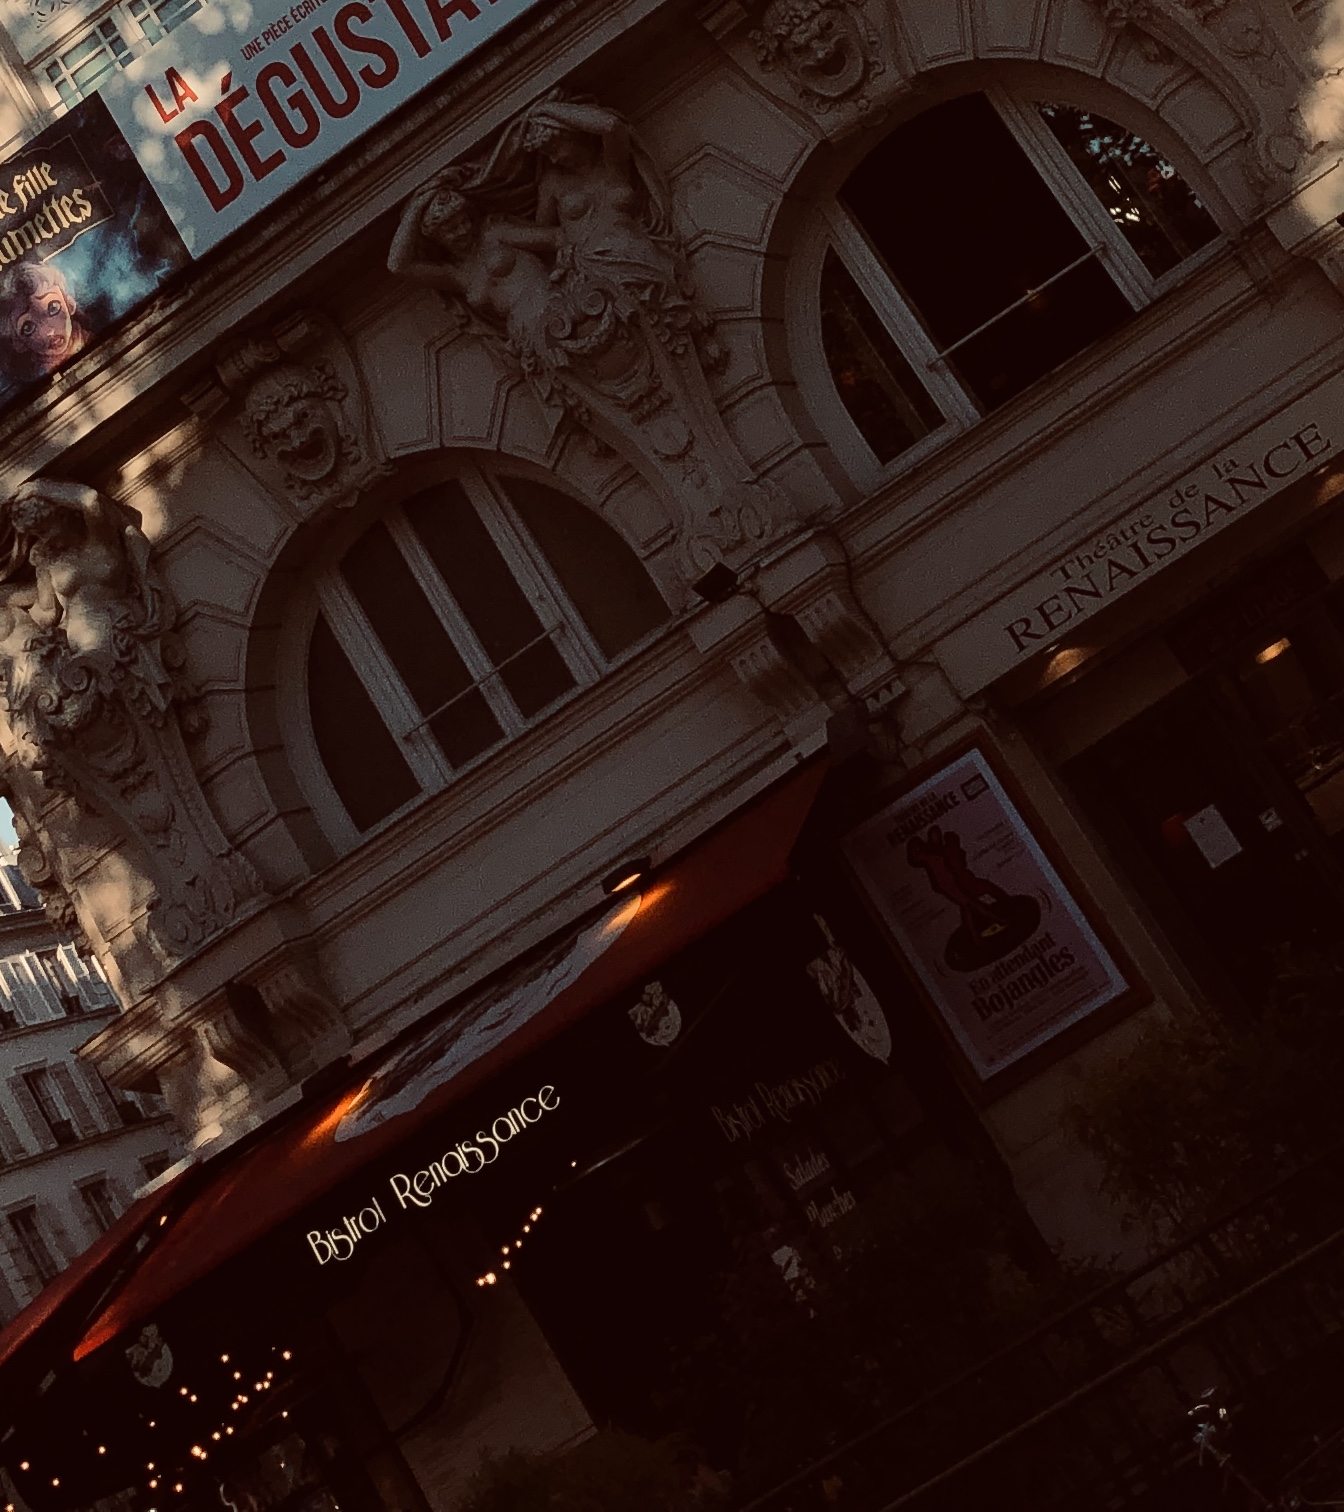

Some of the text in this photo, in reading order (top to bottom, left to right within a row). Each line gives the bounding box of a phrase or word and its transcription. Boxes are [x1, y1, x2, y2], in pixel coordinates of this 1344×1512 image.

[240, 33, 265, 61] UNE
[260, 14, 293, 46] PIÈCE
[144, 66, 198, 124] LA
[12, 160, 58, 214] fille
[1003, 422, 1333, 654] RENAISSANCE
[1050, 455, 1239, 583] Théâtre de la
[971, 945, 1076, 1021] Bojangles
[389, 1084, 561, 1209] Renaissance
